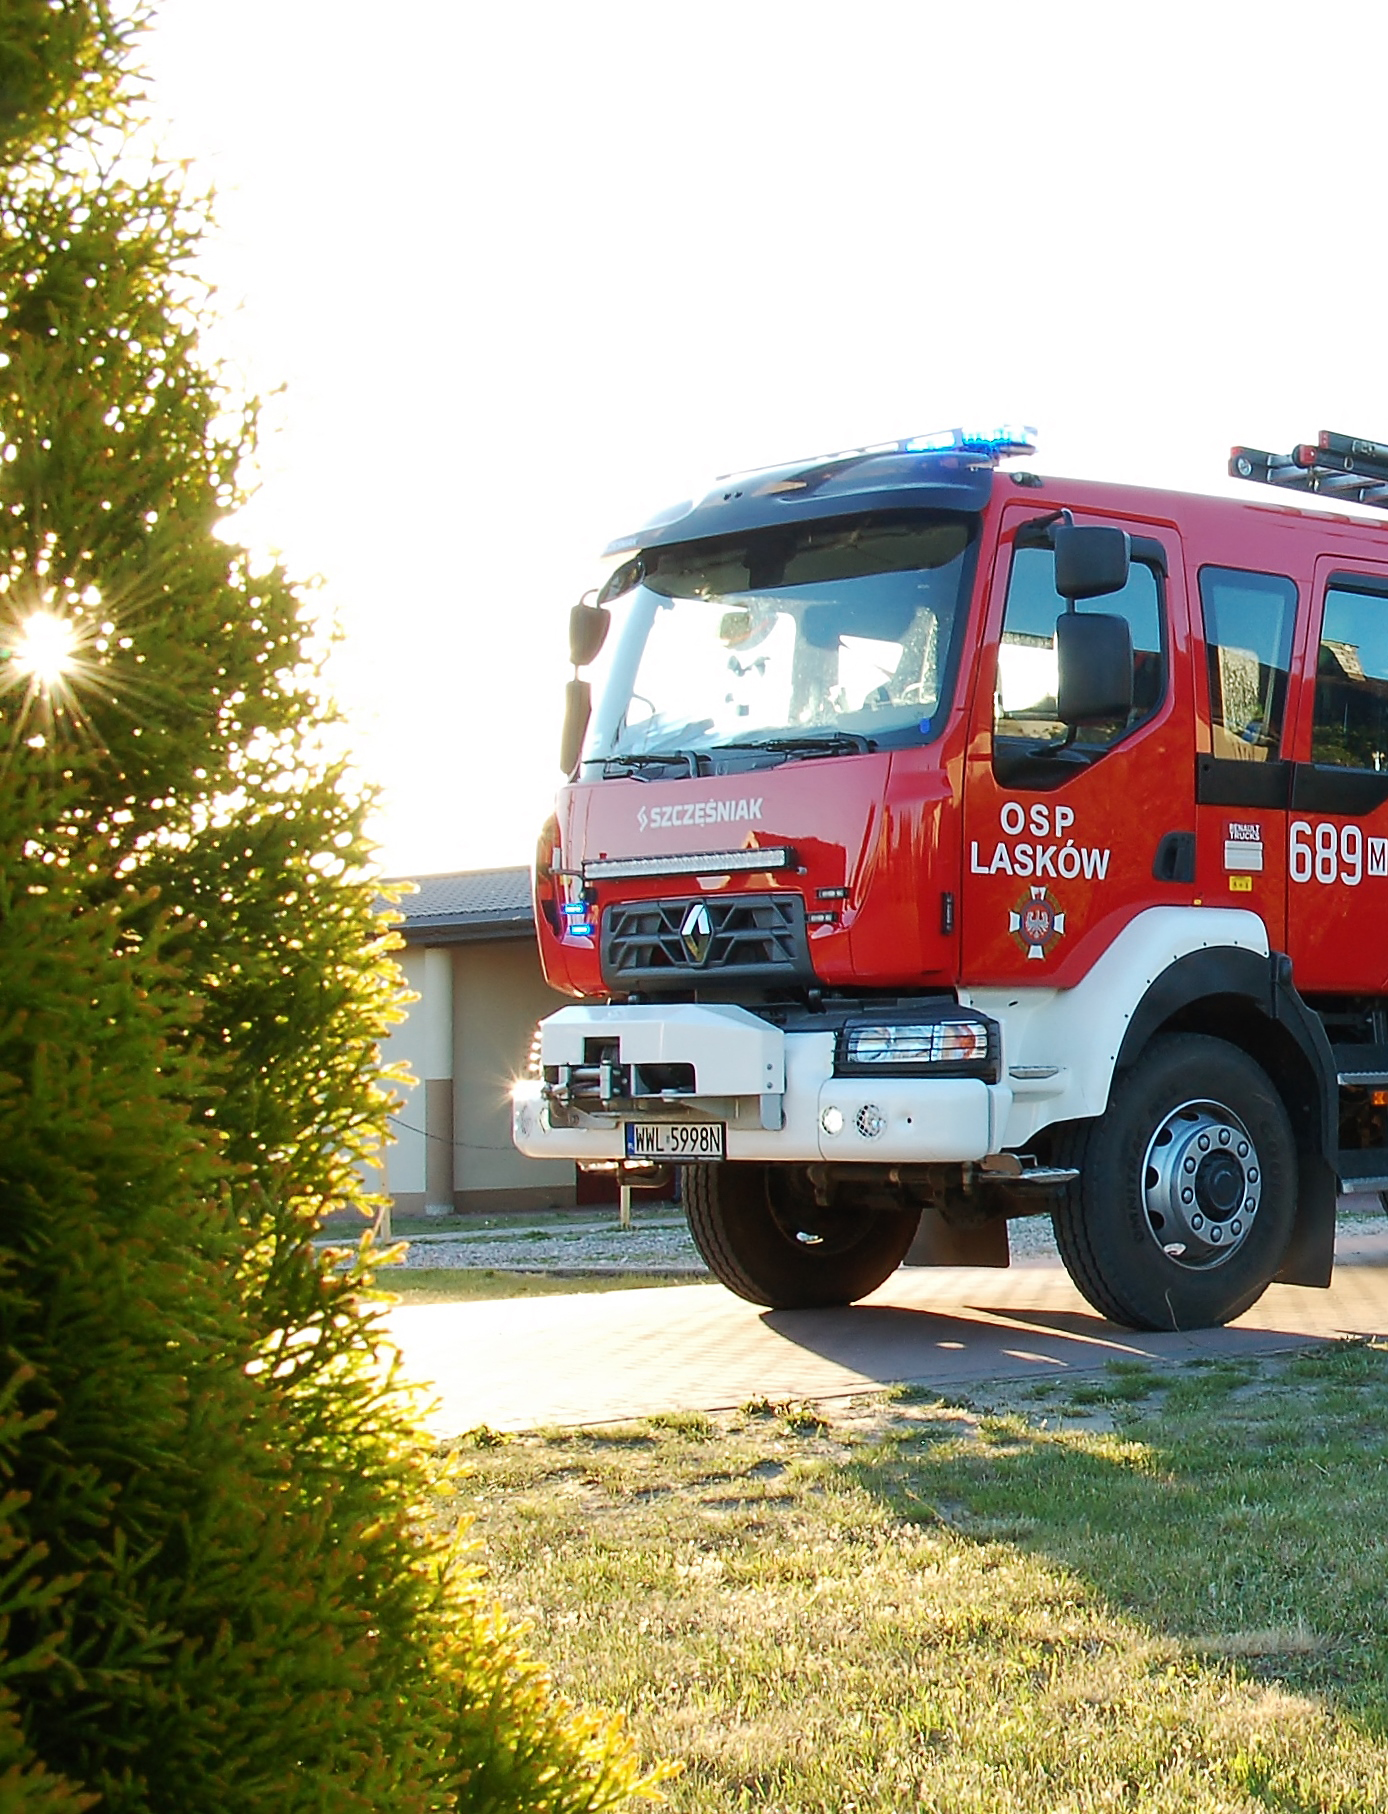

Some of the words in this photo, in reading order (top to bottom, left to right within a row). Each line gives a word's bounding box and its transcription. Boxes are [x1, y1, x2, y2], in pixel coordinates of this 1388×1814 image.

[650, 798, 763, 828] SZCZĘŚNIAK
[1000, 801, 1075, 838] OSP
[970, 839, 1111, 880] LASKÓW
[635, 1126, 665, 1152] WWL
[671, 1126, 720, 1152] 5998N
